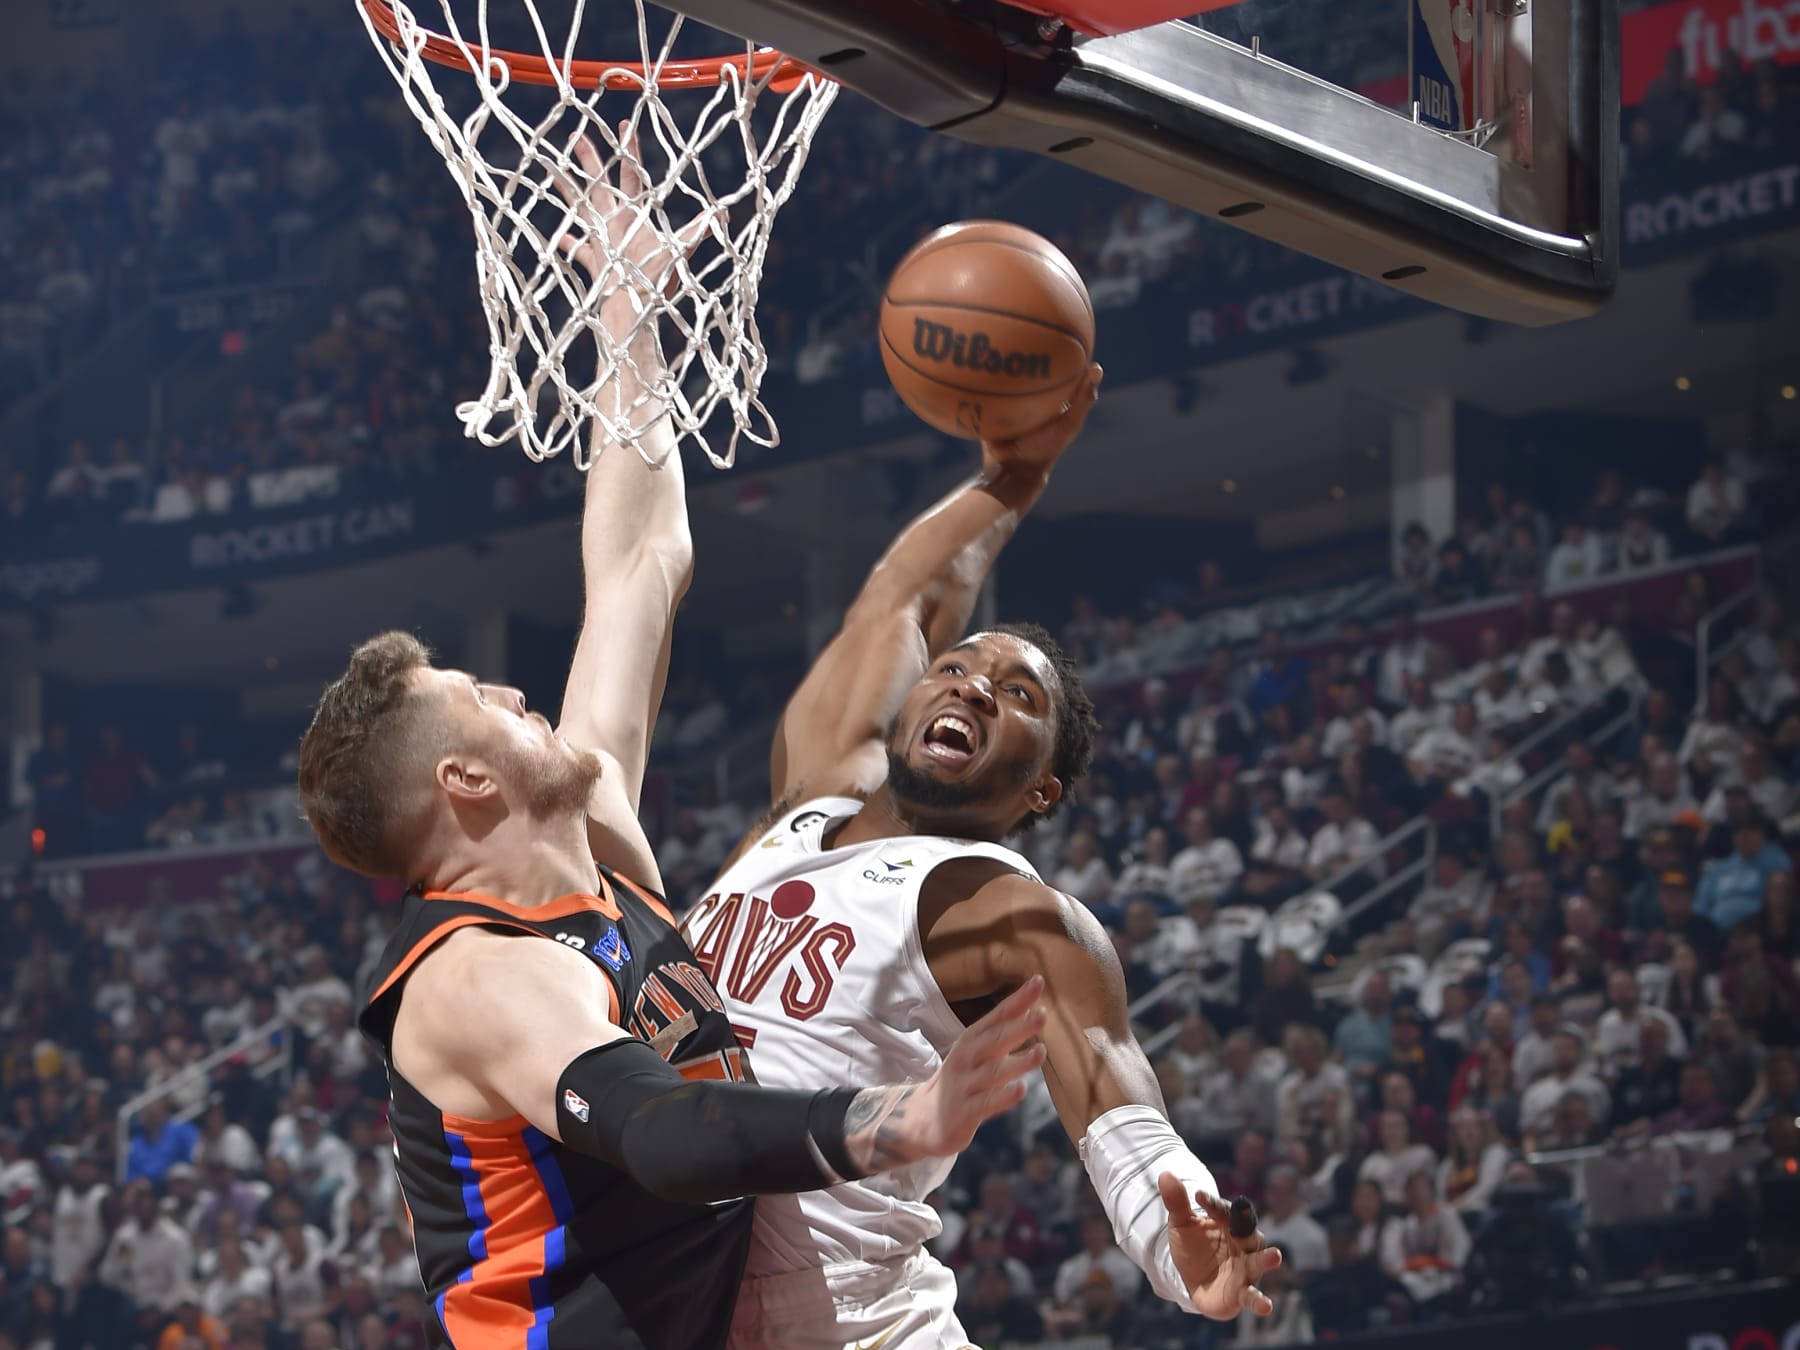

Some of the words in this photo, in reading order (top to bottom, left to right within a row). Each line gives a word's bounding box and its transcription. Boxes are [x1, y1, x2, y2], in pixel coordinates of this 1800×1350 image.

[1419, 74, 1452, 126] NBA
[1627, 165, 1800, 243] ROCKET
[913, 316, 1052, 379] Wilson
[189, 514, 337, 568] ROCKET
